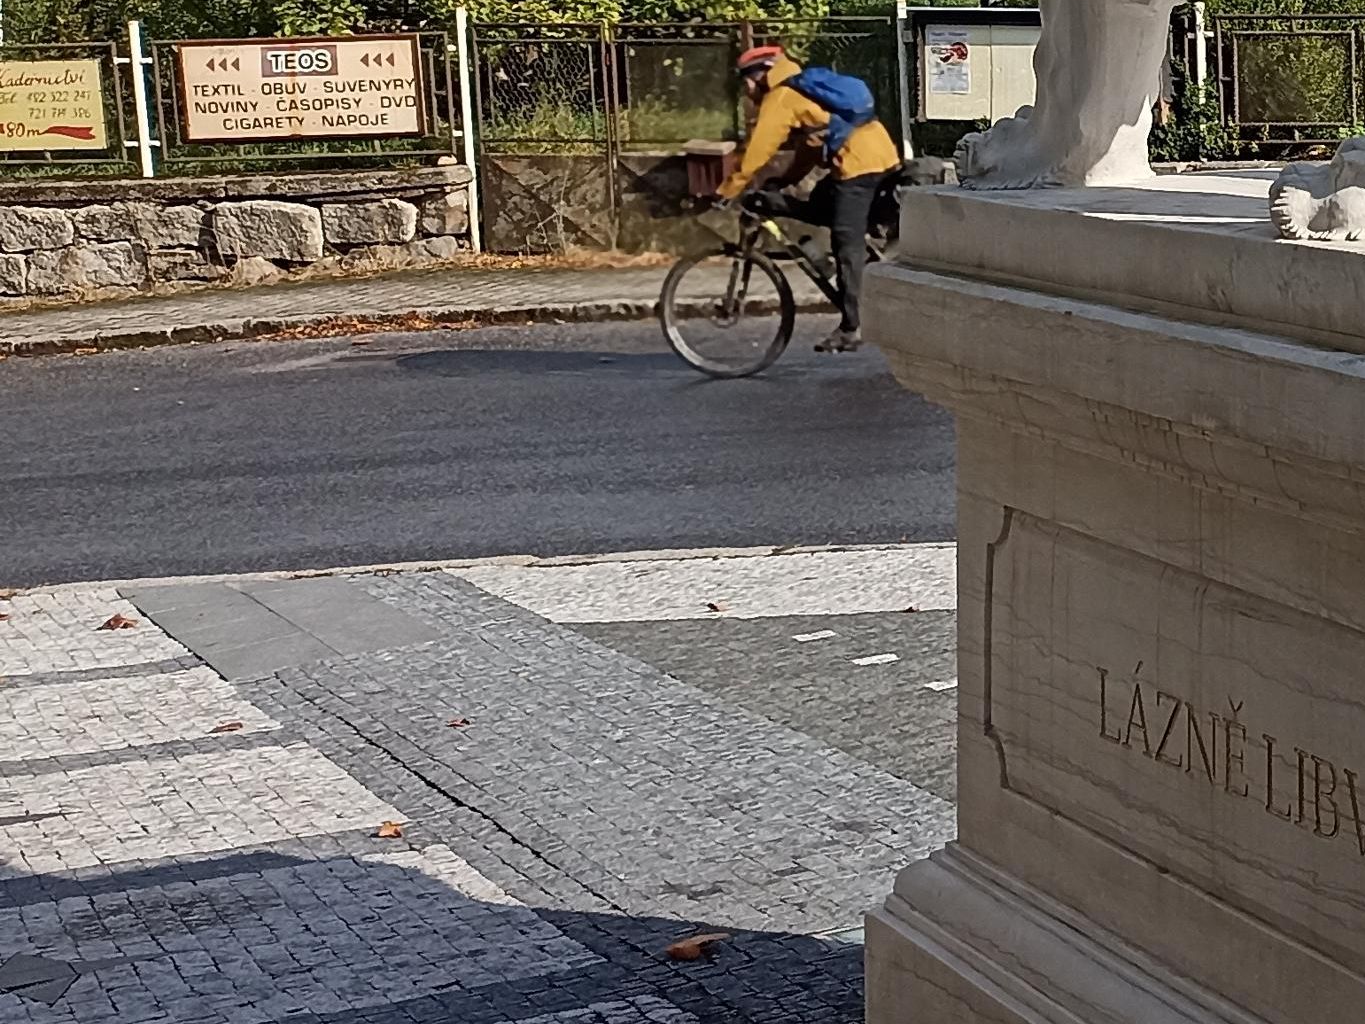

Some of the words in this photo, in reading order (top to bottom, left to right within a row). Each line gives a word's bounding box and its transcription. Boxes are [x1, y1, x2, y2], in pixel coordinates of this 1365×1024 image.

[269, 51, 330, 72] TEOS
[192, 84, 245, 97] TEXTIL
[261, 82, 307, 95] OBUV
[194, 101, 259, 114] NOVINY
[276, 96, 362, 112] ČASOPISY
[380, 95, 417, 108] DVD
[222, 116, 305, 131] CIGARETY
[1096, 660, 1249, 798] LÁZNĚ
